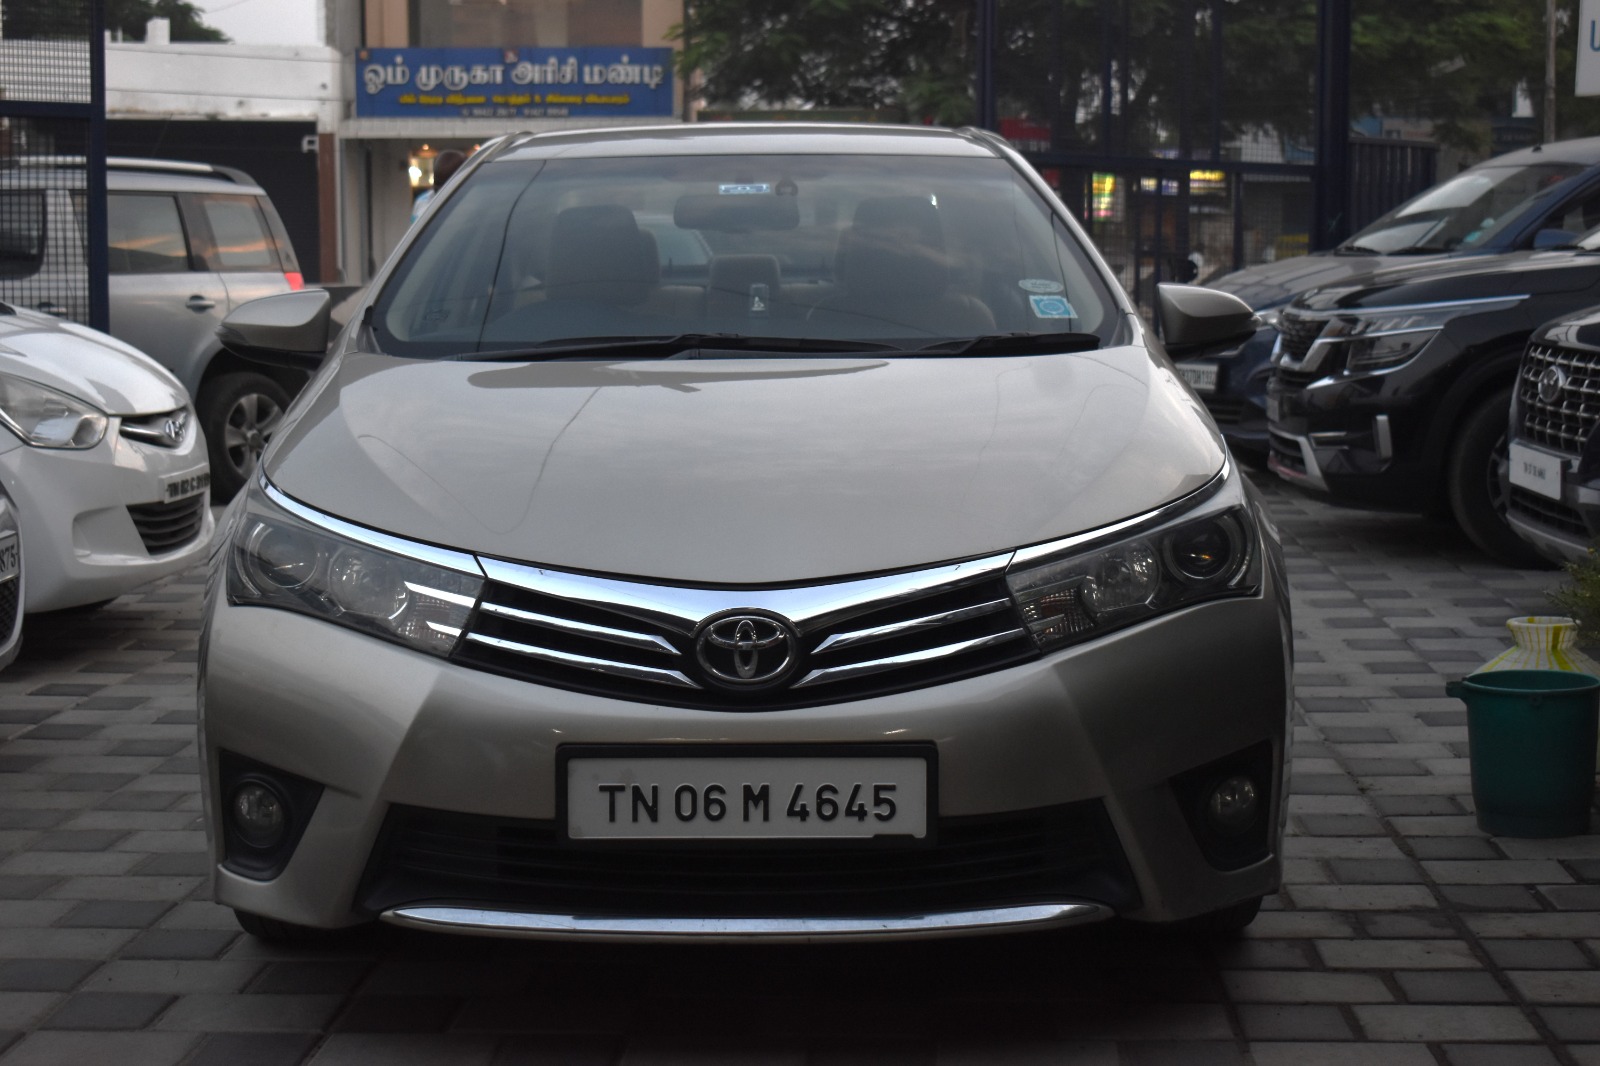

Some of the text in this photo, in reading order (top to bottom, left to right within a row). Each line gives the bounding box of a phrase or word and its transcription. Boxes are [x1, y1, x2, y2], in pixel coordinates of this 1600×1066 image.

[363, 54, 664, 94] ஓம் முருகா அரிசி மண்டி
[599, 784, 897, 823] TN 06 M 4645
